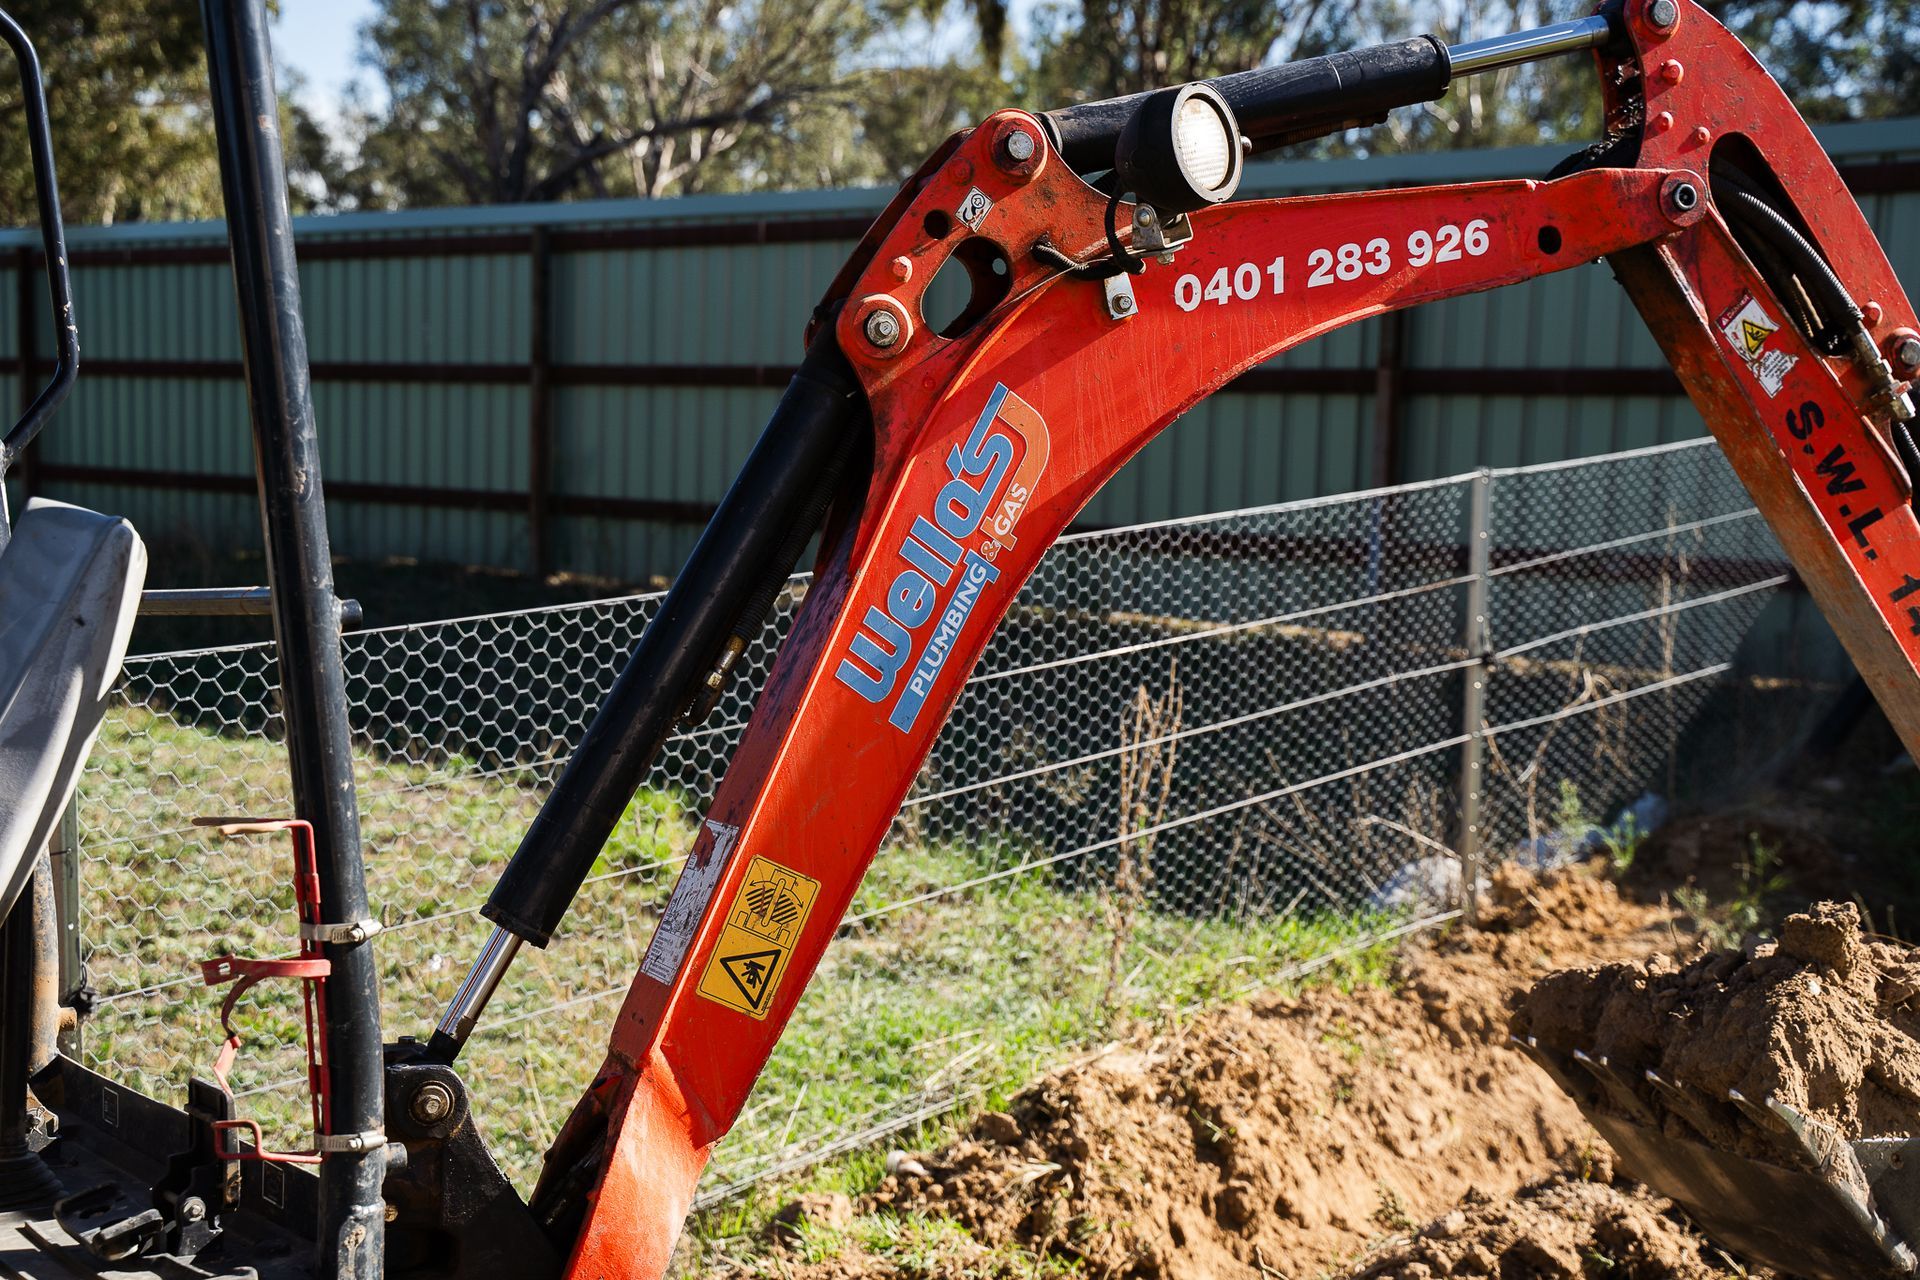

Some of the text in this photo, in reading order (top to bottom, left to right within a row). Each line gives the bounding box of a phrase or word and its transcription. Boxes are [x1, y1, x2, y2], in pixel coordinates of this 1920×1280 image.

[1174, 219, 1489, 313] 0401 283 926
[836, 382, 1013, 703] Wello's
[1785, 400, 1884, 561] S.W.L.
[909, 482, 1028, 698] PLUMBING & GAS
